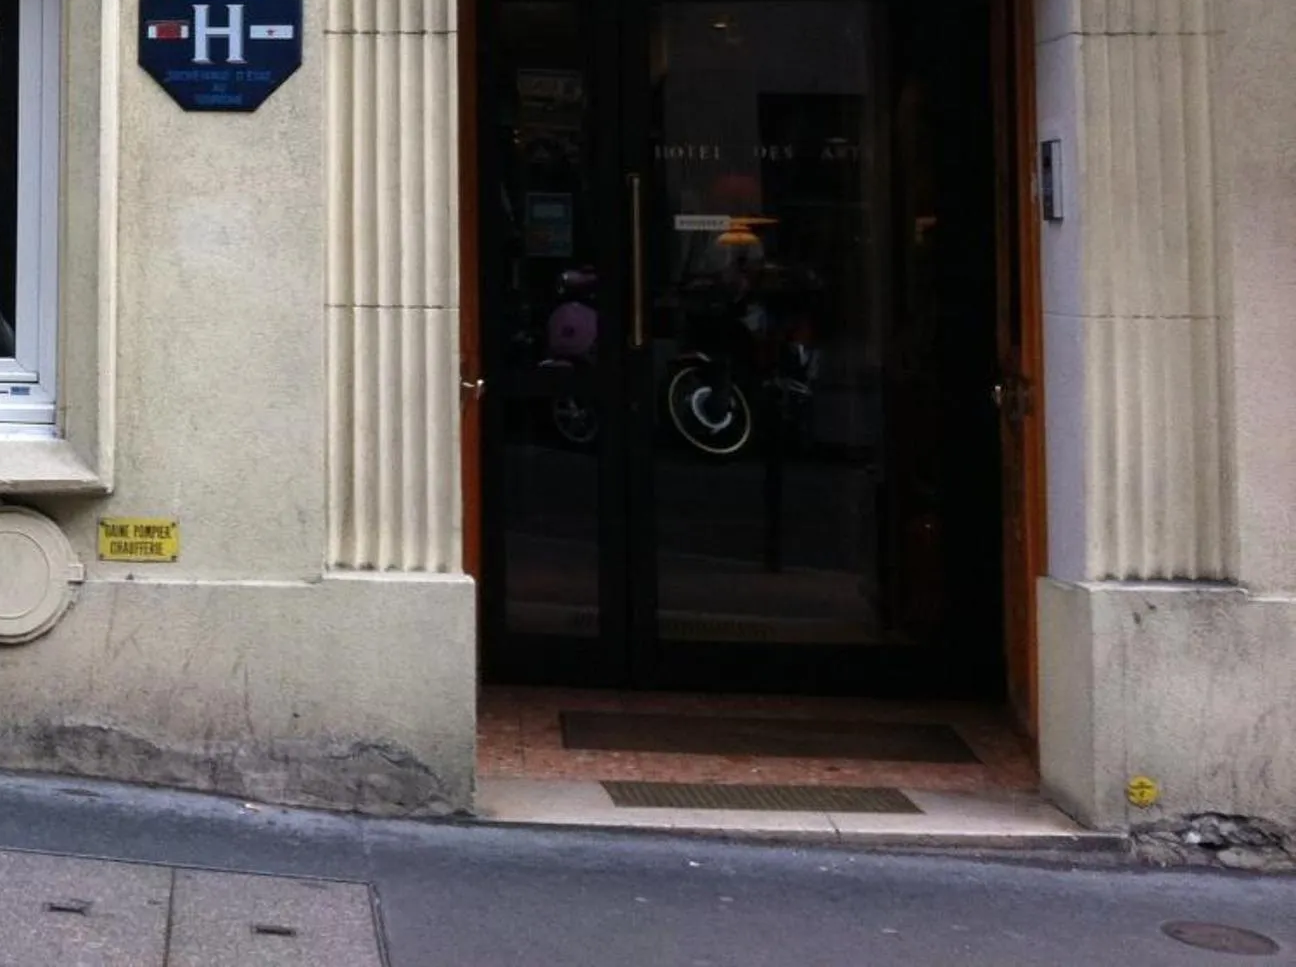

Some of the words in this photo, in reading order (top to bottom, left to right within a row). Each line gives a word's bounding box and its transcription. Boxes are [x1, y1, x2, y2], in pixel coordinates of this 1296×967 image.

[190, 3, 248, 65] H
[134, 524, 173, 539] POMPIER
[110, 540, 166, 556] CHAUFFERIE
